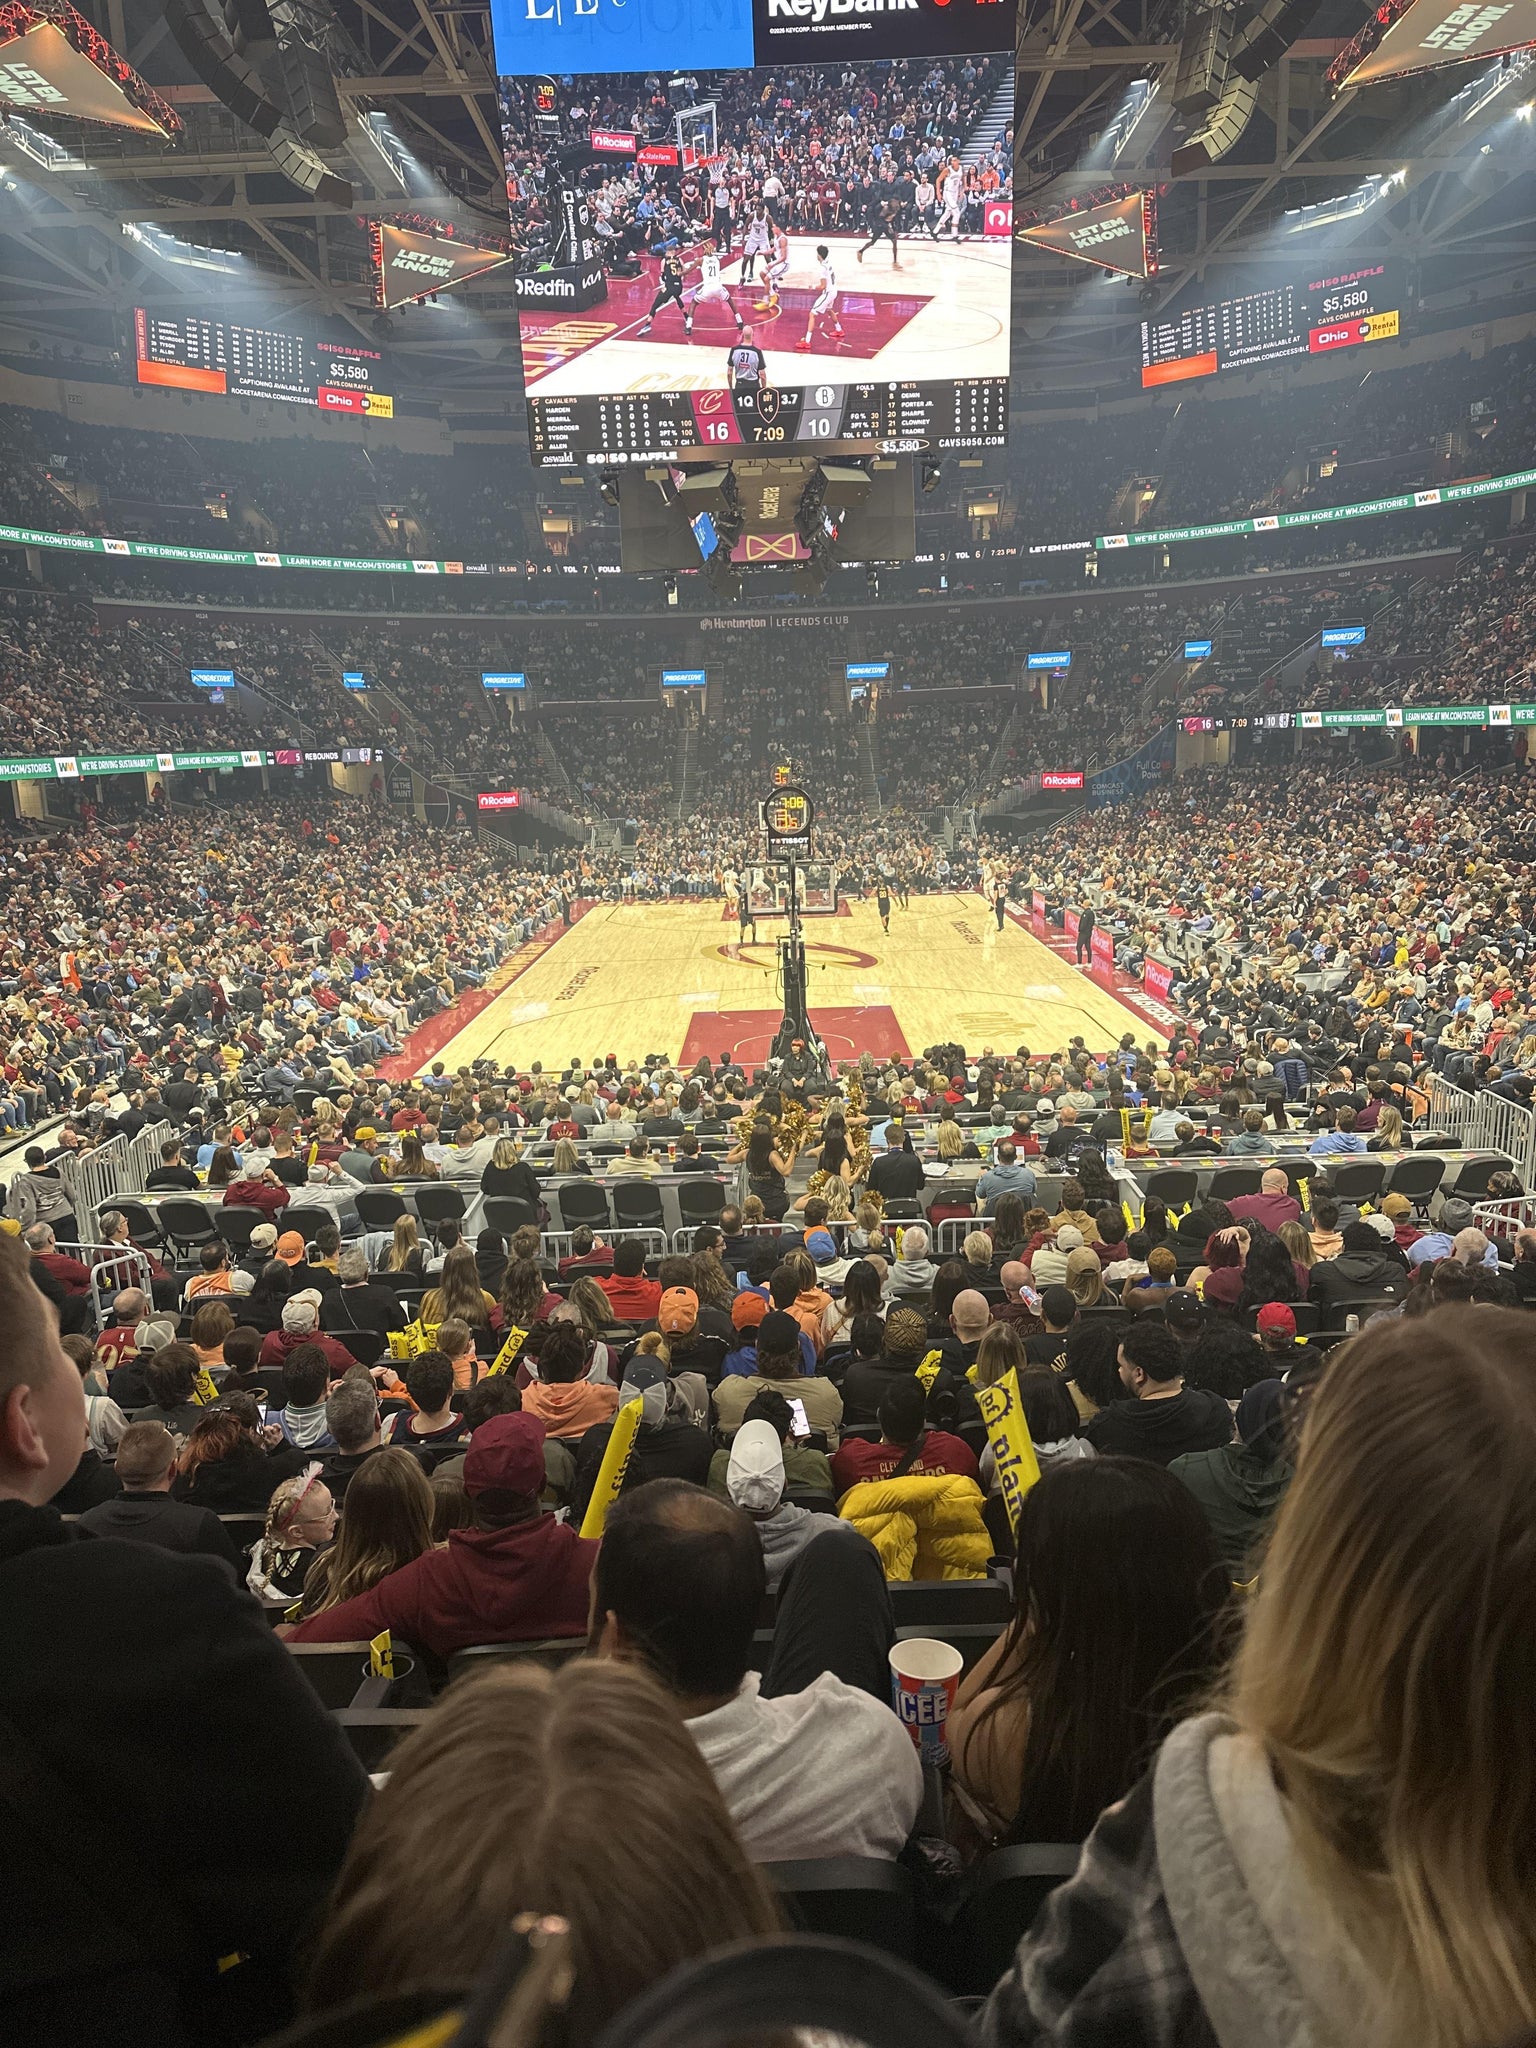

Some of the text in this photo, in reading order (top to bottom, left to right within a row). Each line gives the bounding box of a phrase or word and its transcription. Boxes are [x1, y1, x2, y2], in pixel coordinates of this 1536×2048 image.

[1418, 3, 1483, 49] LET EM
[1442, 3, 1515, 51] KNOW.
[0, 69, 42, 106] NOW.
[3, 62, 69, 103] LET EM
[603, 138, 634, 149] Rocket
[566, 204, 576, 240] Cleveland
[1069, 216, 1126, 240] LET EM
[1074, 225, 1135, 249] KNOW.
[397, 248, 456, 268] LET EM
[391, 257, 450, 278] KNOW.
[708, 265, 716, 277] 21
[1340, 265, 1384, 283] RAFFLE
[524, 278, 575, 297] Redfin
[1323, 290, 1368, 313] $5,580
[1318, 320, 1396, 344] Ohio Rental
[1262, 337, 1292, 350] AVAILABLE
[345, 348, 381, 360] RAFFLE
[740, 352, 749, 363] 37
[330, 363, 368, 380] $5,580
[274, 383, 301, 393] AVAILABLE
[326, 394, 391, 410] Ohio Rental
[737, 396, 754, 407] 1Q
[781, 394, 798, 405] 3.7
[764, 405, 774, 413] +6
[707, 422, 729, 440] 16
[753, 427, 785, 441] 7:09
[808, 418, 831, 437] 10
[882, 436, 1005, 453] $5,580 CAVS5050.COM
[543, 452, 573, 463] oswald
[631, 451, 677, 462] RAFFLE
[1447, 486, 1472, 498] WE'RE
[1473, 480, 1503, 493] DRIVING
[1285, 498, 1409, 524] LEARN MORE AT WM.COM/STORIES
[0, 528, 95, 549] MORE AT WM.COM/STORIES
[1134, 533, 1157, 543] WE'RE
[1159, 530, 1189, 541] DRIVING
[135, 545, 159, 555] WE'RE
[160, 547, 188, 558] DRIVING
[912, 555, 934, 563] OULS
[955, 552, 970, 560] TOL
[1029, 546, 1047, 554] LET
[286, 557, 310, 566] LEARN
[311, 558, 332, 567] MORE
[343, 561, 408, 570] WM.COM/STORIES
[542, 565, 552, 573] +6
[1029, 655, 1068, 665] PROGRESSIVE
[848, 666, 887, 675] PROGRESSIVE
[483, 676, 522, 685] PROGRESSIVE
[665, 674, 703, 682] PROGRESSIVE
[1405, 712, 1421, 721] LEARN
[1421, 712, 1434, 721] MORE
[1492, 709, 1509, 720] WM
[1515, 709, 1535, 719] WE'RE
[1201, 716, 1276, 729] 16 7:09 10
[305, 752, 339, 761] REBOUNDS
[58, 762, 75, 772] WM
[81, 760, 99, 770] WE'RE
[99, 759, 118, 770] DRIVING
[1136, 761, 1149, 770] Full
[1052, 776, 1081, 785] Rocket
[488, 795, 517, 805] Rocket
[880, 1459, 924, 1473] CLEVAND
